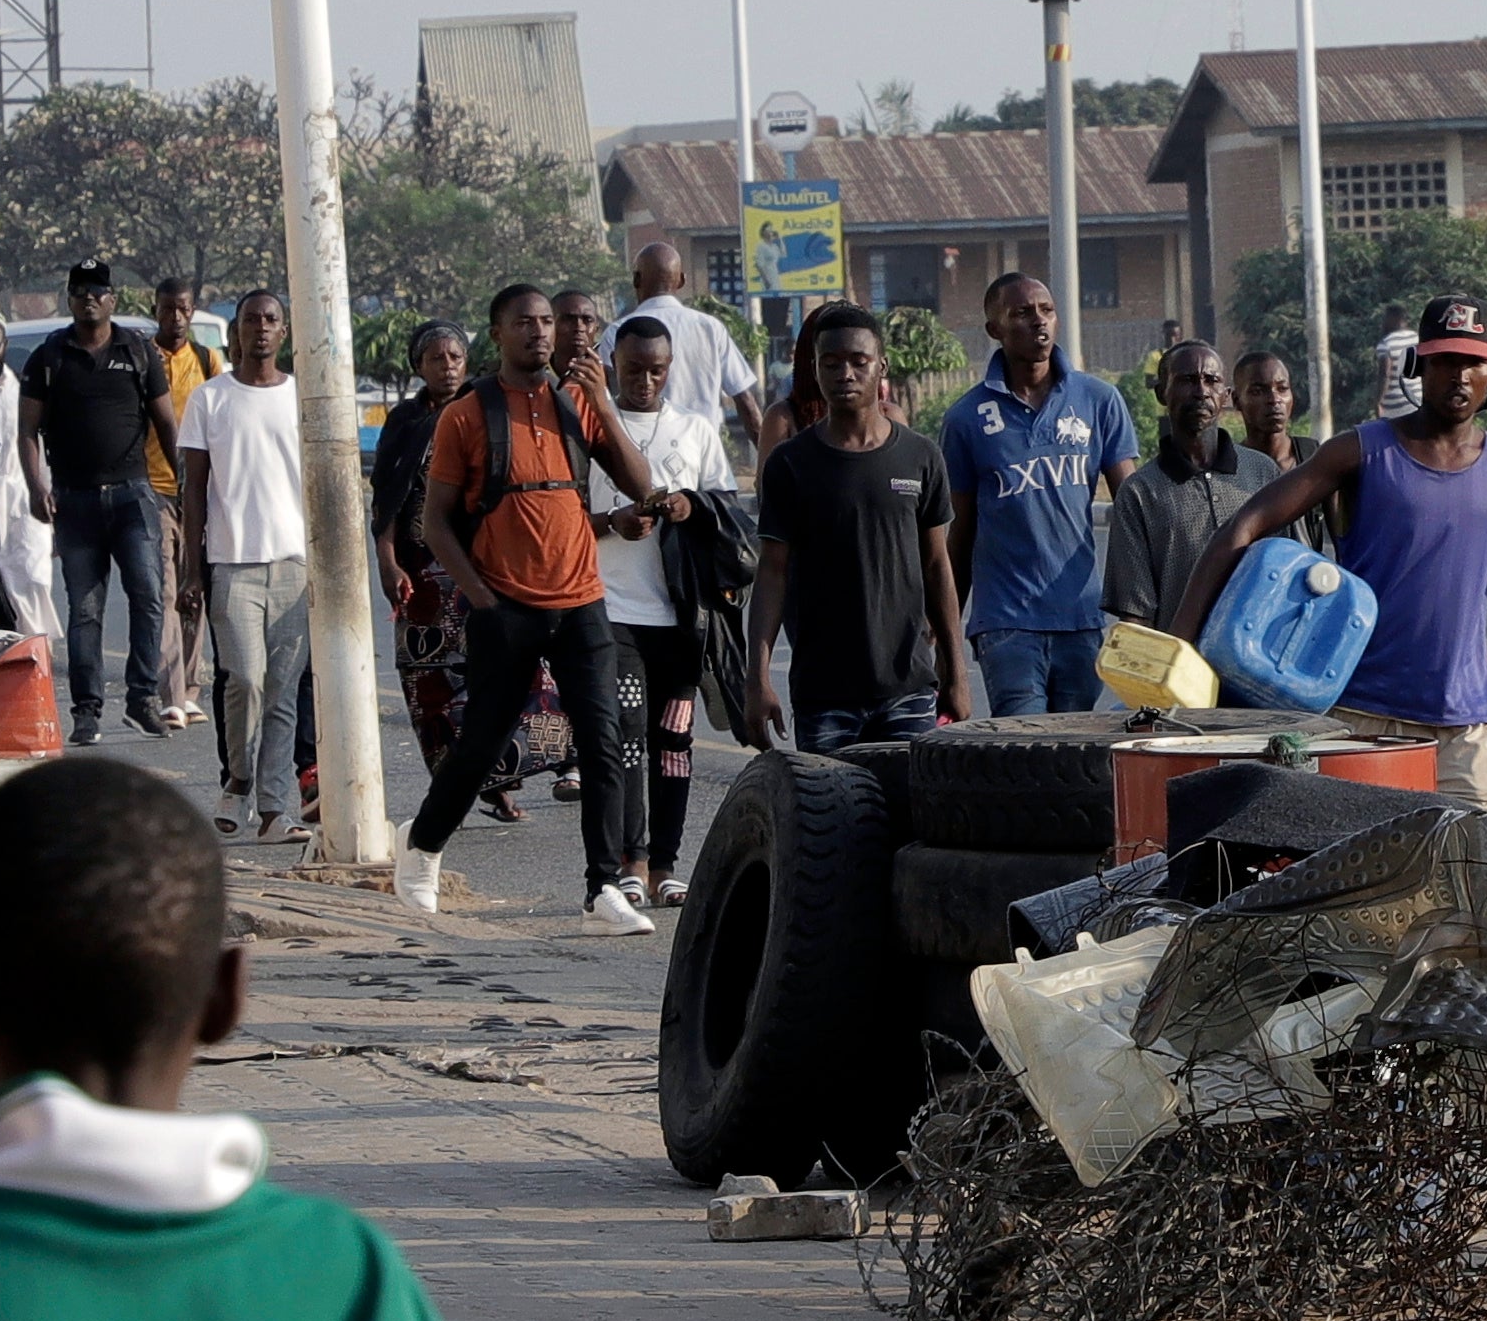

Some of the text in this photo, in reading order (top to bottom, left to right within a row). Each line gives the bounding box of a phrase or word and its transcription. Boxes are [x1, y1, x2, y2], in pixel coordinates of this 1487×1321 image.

[766, 110, 808, 119] BUS STOP
[774, 188, 832, 205] LUMITEL
[977, 400, 1005, 435] 3
[994, 454, 1090, 498] LXVII
